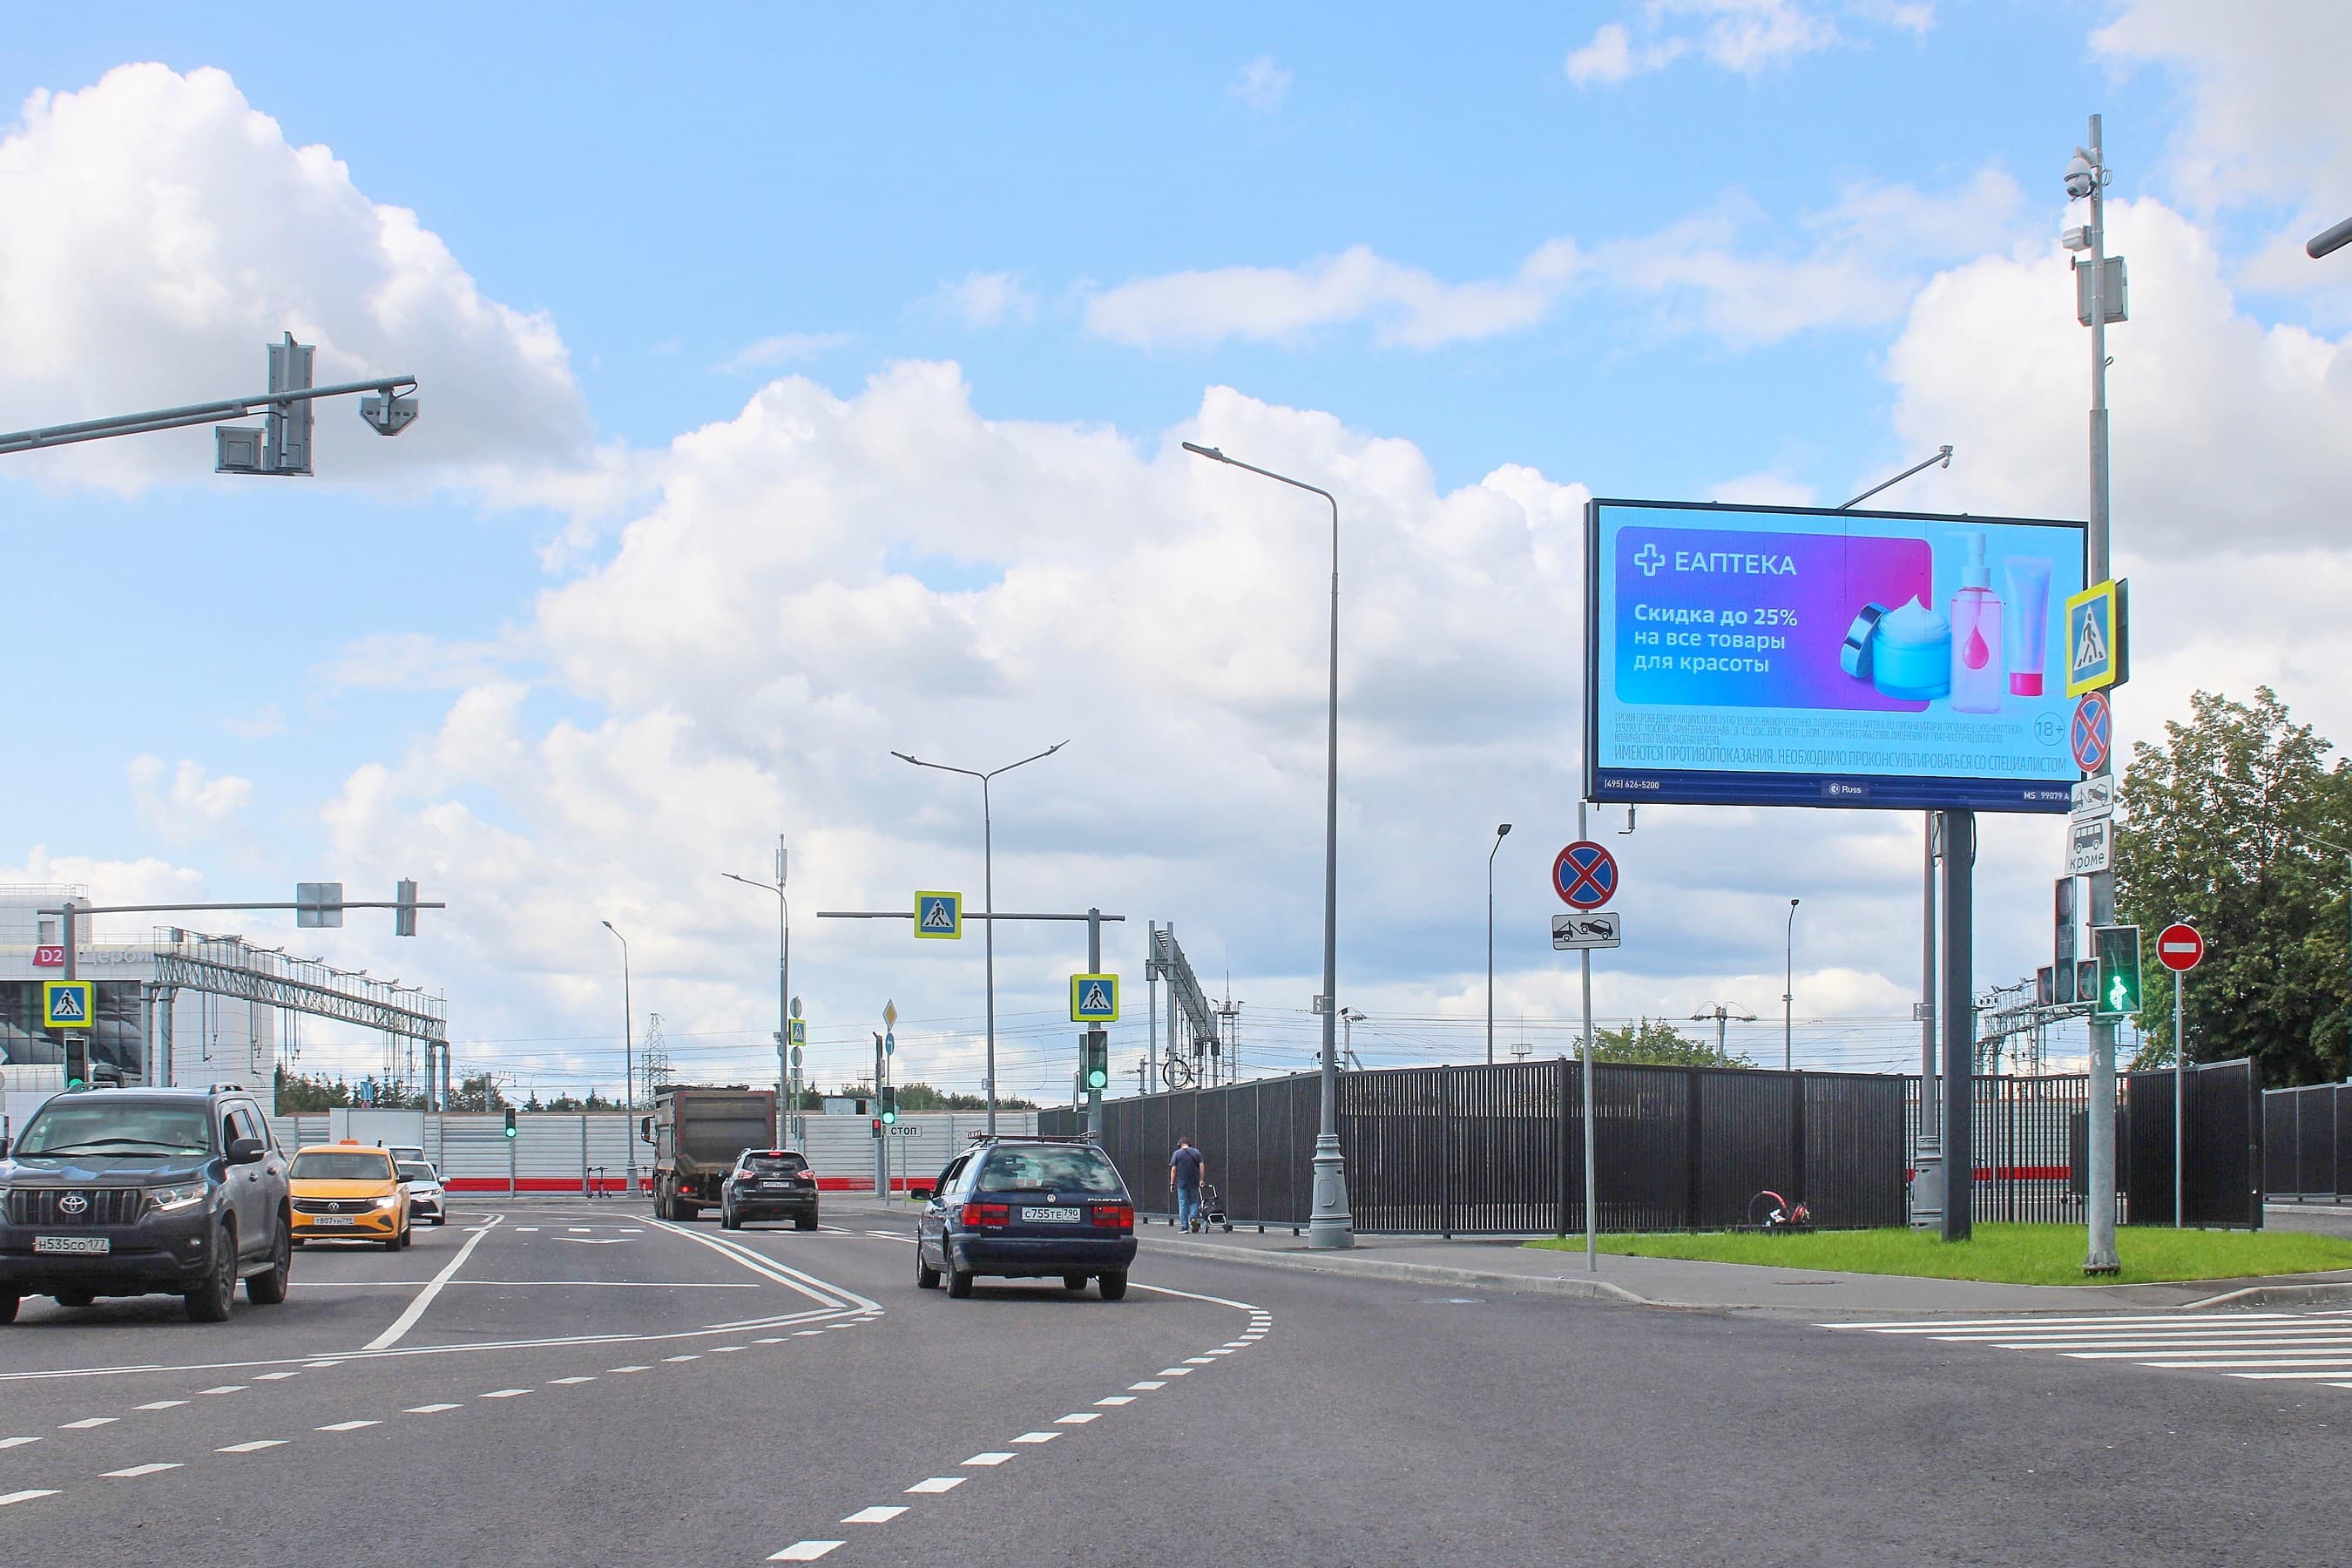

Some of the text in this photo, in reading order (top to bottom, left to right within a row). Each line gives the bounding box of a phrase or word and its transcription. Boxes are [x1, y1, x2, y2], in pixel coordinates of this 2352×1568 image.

[1675, 551, 1797, 575] ЕАПТЕКА
[1634, 604, 1799, 626] Скидка до 25%
[1634, 631, 1785, 652] на все товары
[1633, 655, 1769, 674] для красоты
[2035, 721, 2065, 737] 18+
[1615, 746, 2066, 773] ИМЕЮТСЯ ПРОТИВОПОКАЗАНИЯ. НЕОБХОДИМО ПРОКОНСУЛЬТИРОВАТЬСЯ СО СПЕЦИАЛИСТОМ
[1625, 781, 1659, 789] 626-5200
[2070, 853, 2105, 871] кроме
[40, 950, 63, 962] D2
[39, 1239, 85, 1250] Н535СО
